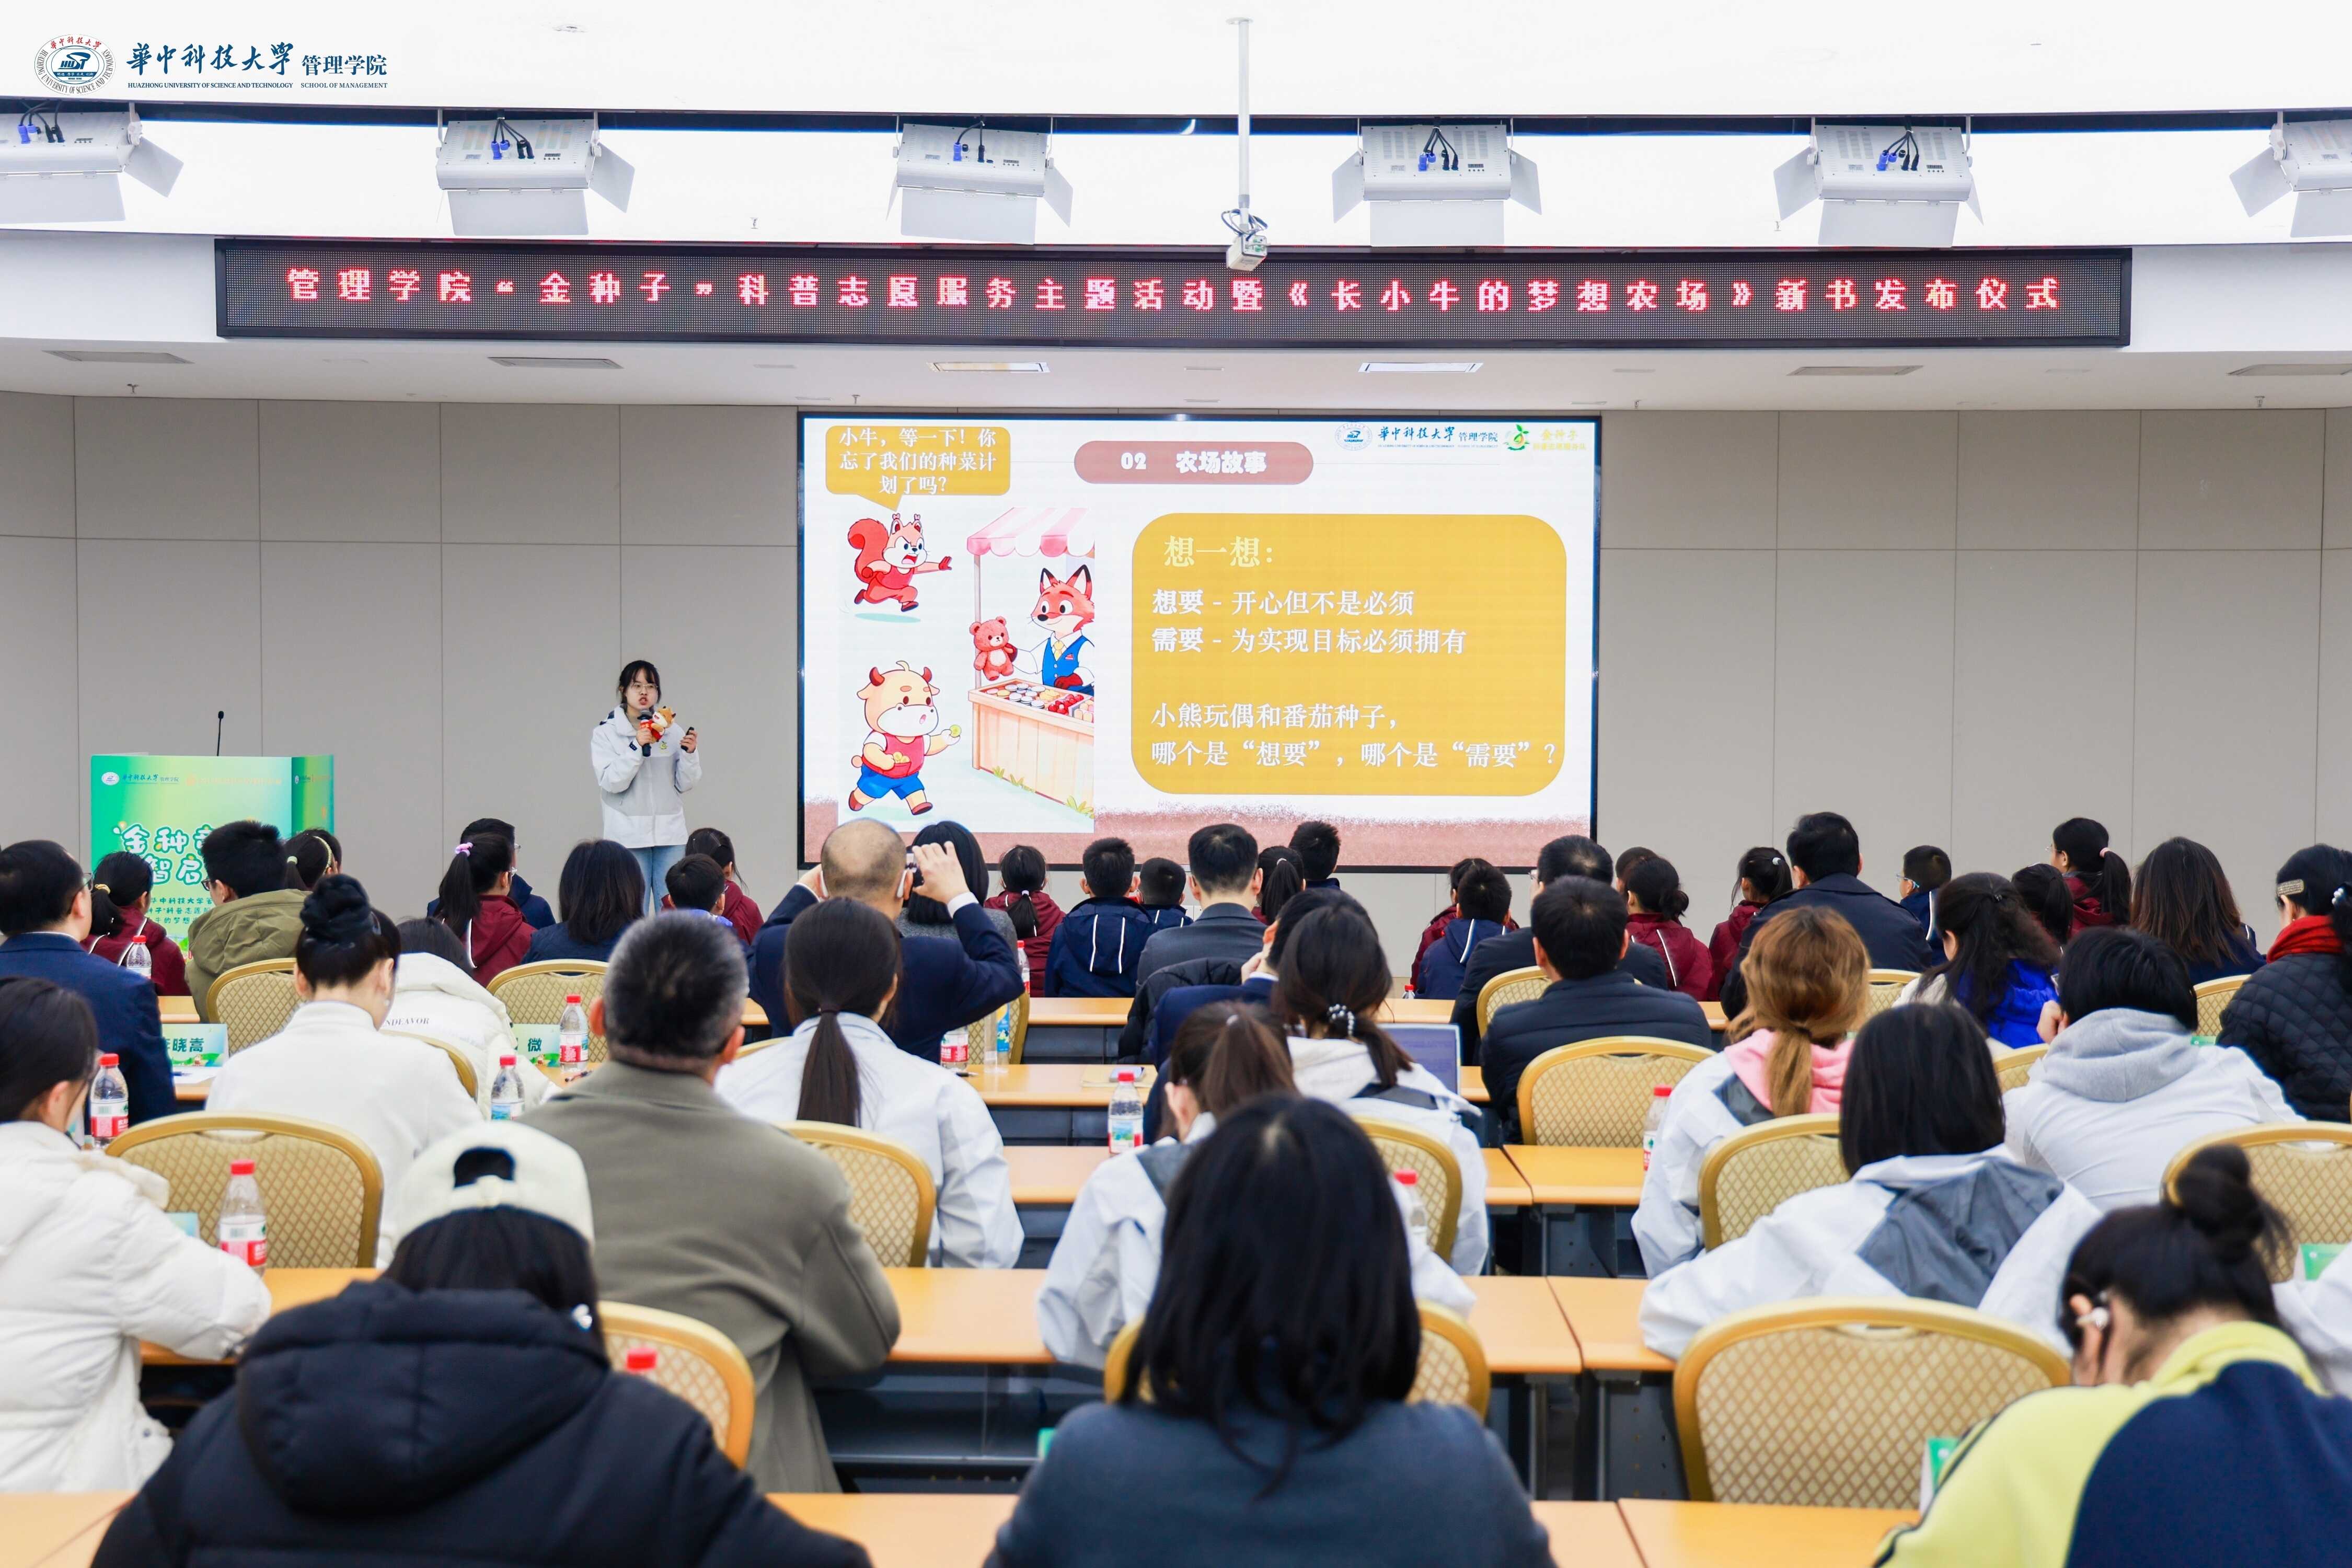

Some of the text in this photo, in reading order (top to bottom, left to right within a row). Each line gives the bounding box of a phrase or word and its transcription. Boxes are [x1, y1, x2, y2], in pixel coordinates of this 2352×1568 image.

[1458, 431, 1498, 442] 管理学院
[839, 452, 996, 471] 忘了我们的种菜计
[1121, 451, 1267, 474] 02 农场故事
[879, 476, 947, 495] 划了吗？
[1163, 535, 1274, 568] 想一想：
[1151, 589, 1204, 616] 想要
[1231, 590, 1415, 616] 开心但不是必须
[1151, 627, 1204, 653] 需要
[1231, 628, 1467, 655] 为实现目标必须拥有
[1151, 702, 1398, 730] 小熊玩偶和番茄种子，
[386, 1017, 430, 1026] NDEAVOR
[527, 1037, 543, 1052] 微
